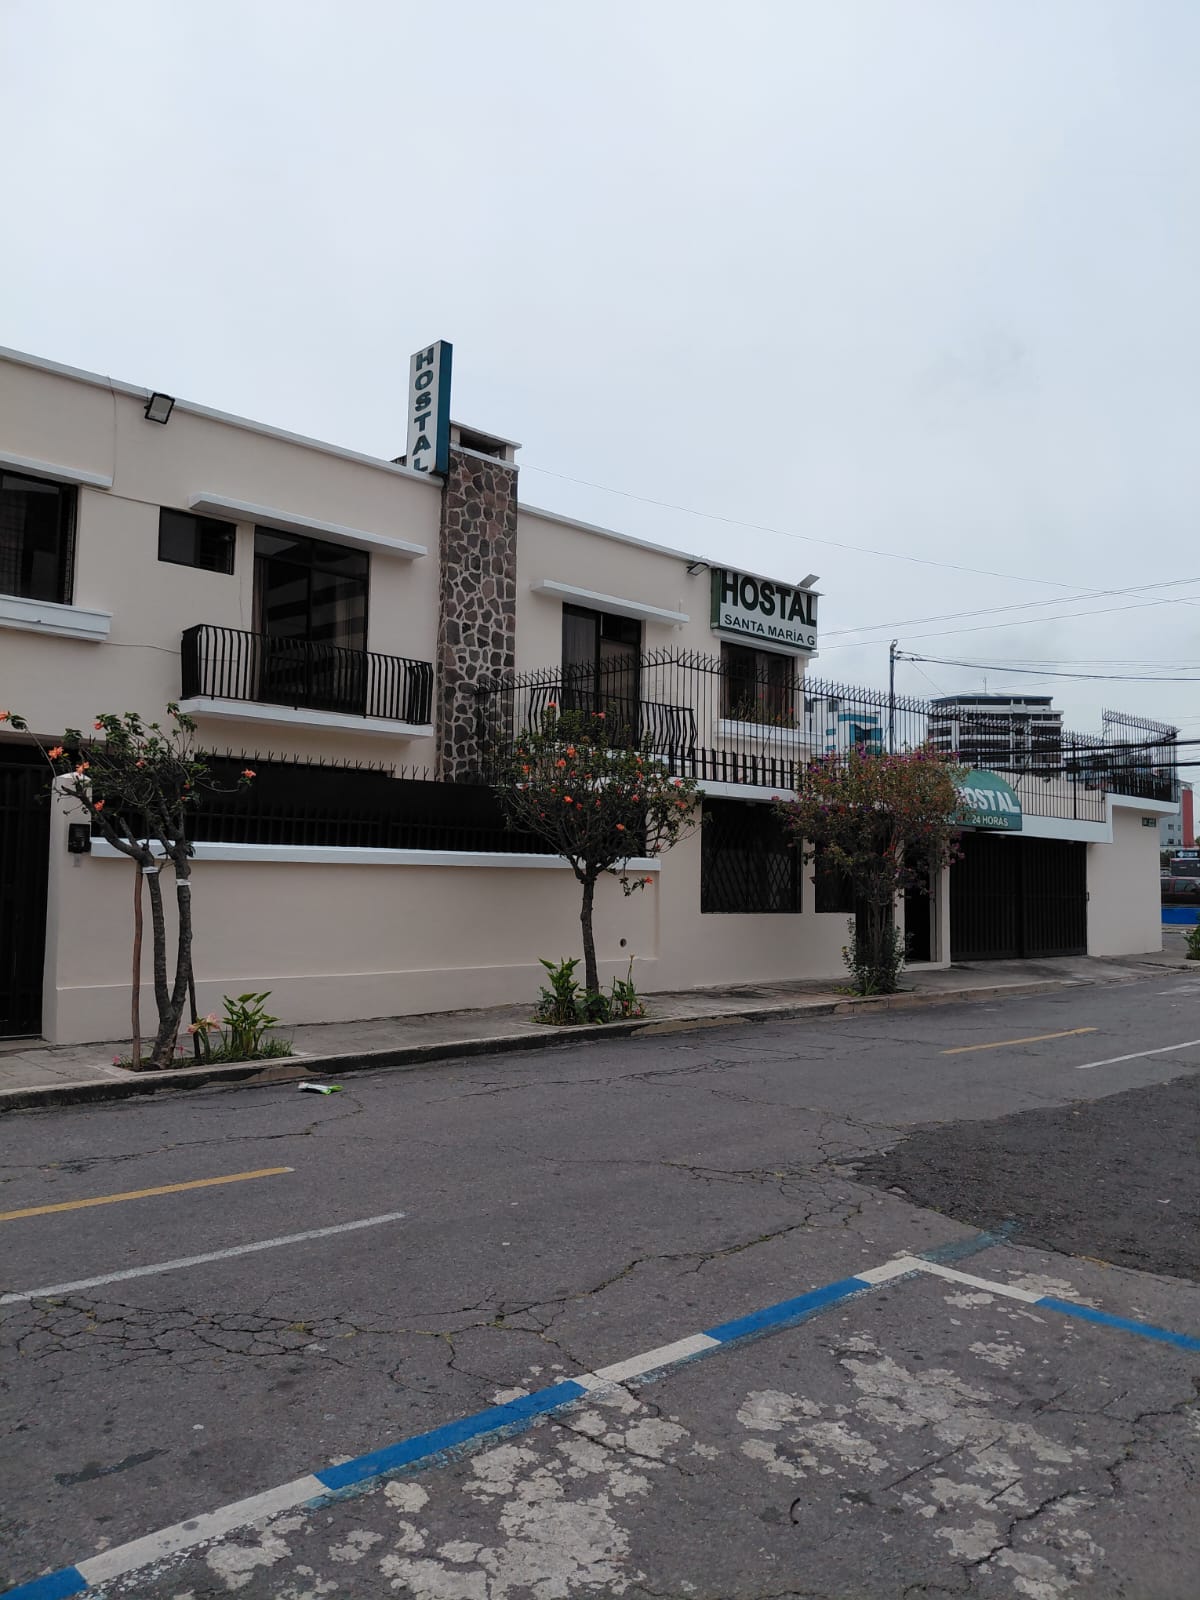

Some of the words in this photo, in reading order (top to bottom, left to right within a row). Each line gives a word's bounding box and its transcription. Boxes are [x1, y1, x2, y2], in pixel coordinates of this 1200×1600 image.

[412, 347, 434, 472] HOSTAL
[721, 569, 817, 627] HOSTAL
[724, 614, 765, 634] SANTA
[768, 625, 804, 644] MARÍA
[807, 635, 815, 646] G
[972, 815, 981, 825] 24
[982, 816, 1009, 827] HORAS
